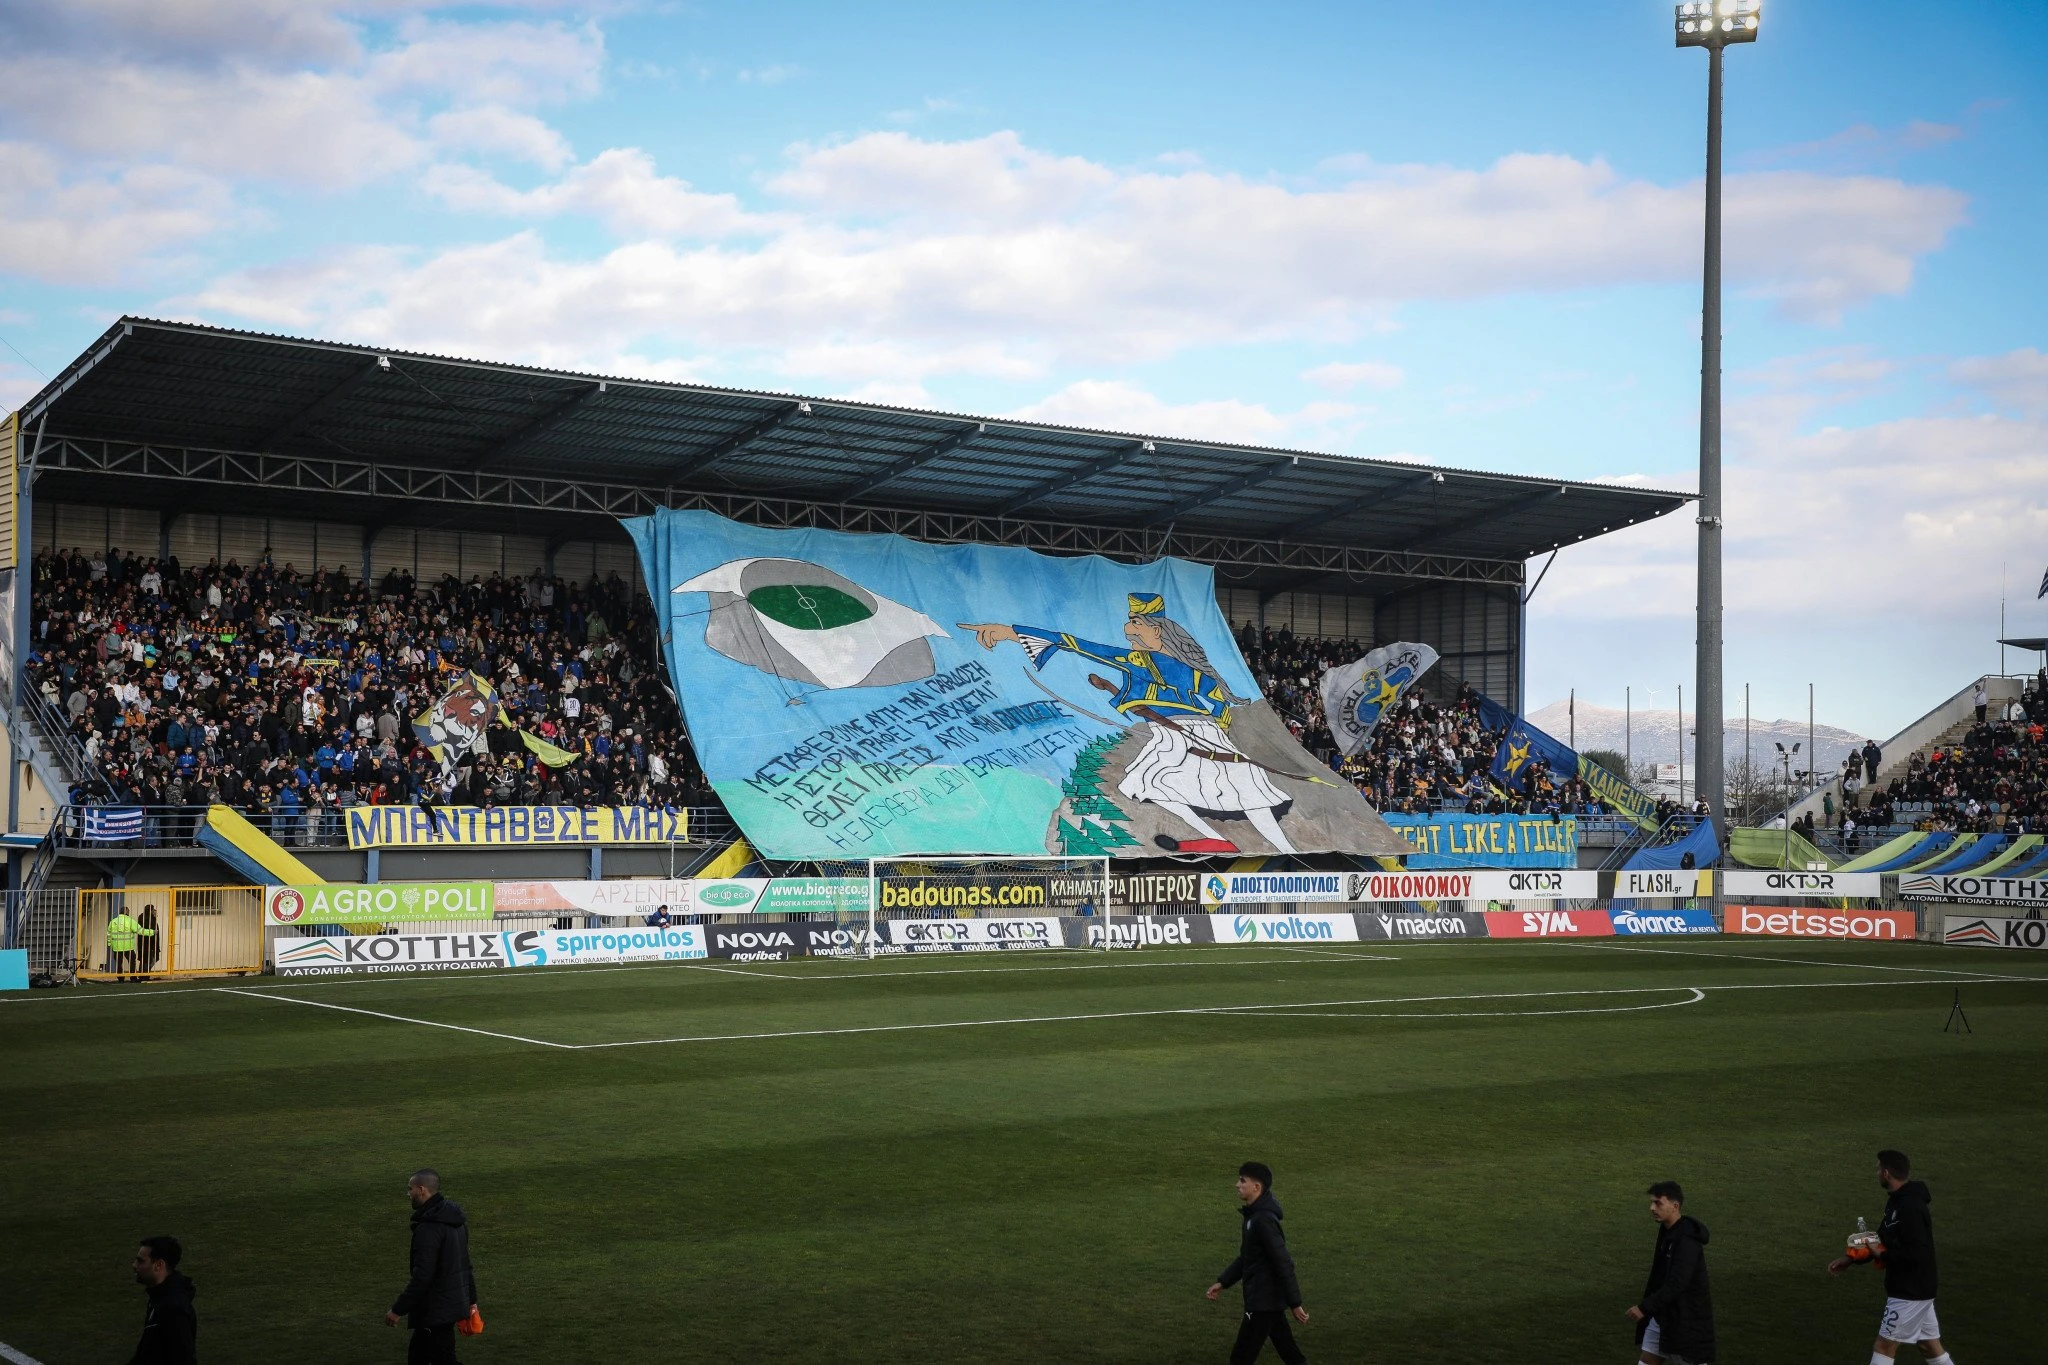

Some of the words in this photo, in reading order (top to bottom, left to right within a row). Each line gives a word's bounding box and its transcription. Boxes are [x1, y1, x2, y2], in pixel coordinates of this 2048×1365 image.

[802, 777, 870, 828] ΘΕΛΕΙ
[934, 726, 979, 750] ΑΥΤΟ
[826, 832, 853, 850] Η
[934, 768, 970, 795] ΔΕΝ
[1450, 823, 1503, 854] LIKE
[1507, 822, 1517, 854] A
[591, 883, 690, 903] ΑΡΣΕΝΗΣ
[882, 881, 1044, 907] badounas.com
[1129, 875, 1197, 903] ΠΙΤΕΡΟΣ
[1231, 876, 1340, 893] ΑΠΟΣΤΟΛΟΠΟΥΛΟΣ
[1370, 875, 1472, 898] ΟΙΚΟΝΟΜΟΥ
[1630, 873, 1682, 894] FLASH.gr
[311, 888, 397, 914] AGRO
[425, 888, 486, 912] POLI
[670, 904, 690, 912] ΚΤΕΟ
[1903, 895, 1949, 903] ΛΑΤΟΜΕΙΑ
[1958, 897, 1991, 905] ΕΤΟΙΜΟ
[1261, 917, 1332, 939] volton
[1397, 917, 1466, 935] macron
[1522, 912, 1578, 936] SYM
[1626, 916, 1688, 934] avance
[1741, 907, 1896, 938] betsson
[556, 927, 694, 956] spiropoulos
[716, 931, 795, 949] NOVA
[809, 929, 883, 946] NOVA
[2005, 921, 2048, 947] ΚΟ
[345, 935, 500, 962] ΚΟΤΤΗΣ
[664, 950, 706, 960] DAIKIN
[731, 950, 783, 961] novibet
[814, 946, 856, 956] novibet
[914, 943, 954, 952] novibet
[961, 941, 1001, 951] novibet
[1007, 939, 1046, 950] novibet
[283, 967, 353, 976] ΛΑΤΟΜΕΙΑ
[367, 964, 416, 973] ΕΤΟΙΜΟ
[420, 961, 498, 972] ΣΚΥΡΟΔΕΜΑ
